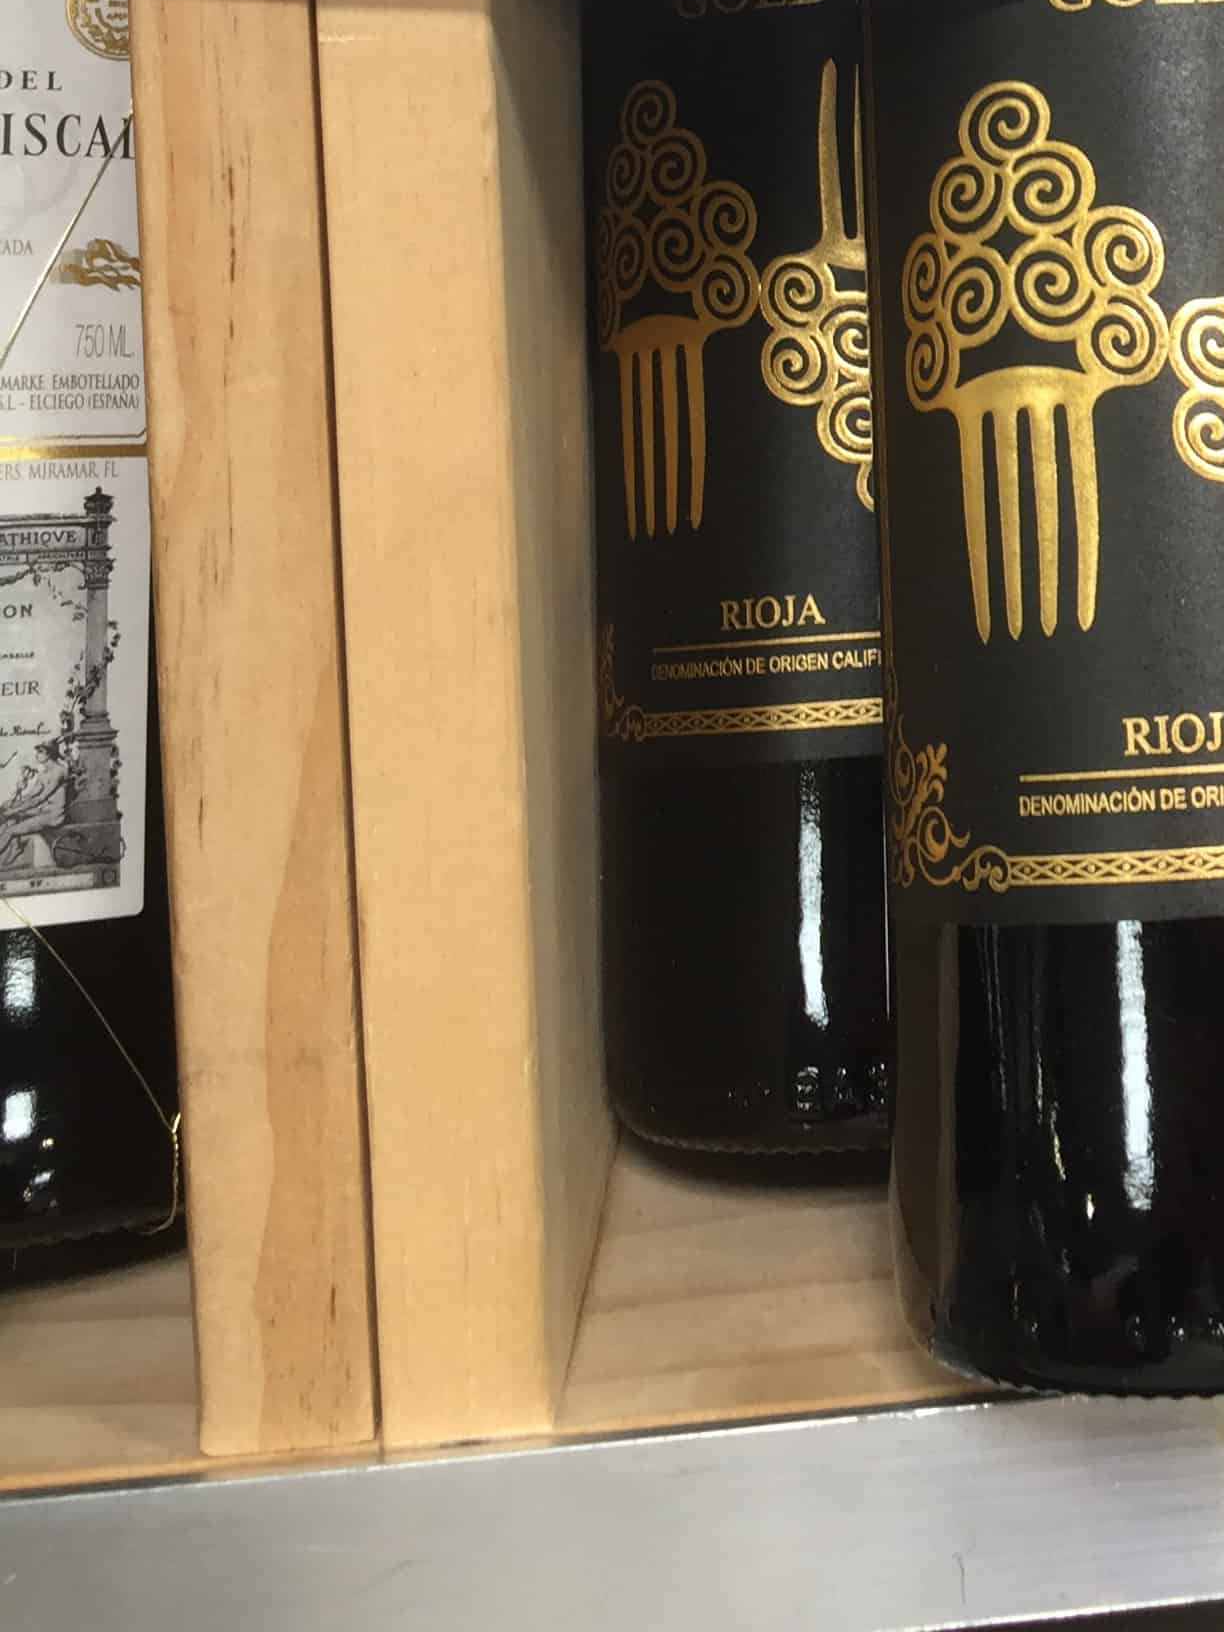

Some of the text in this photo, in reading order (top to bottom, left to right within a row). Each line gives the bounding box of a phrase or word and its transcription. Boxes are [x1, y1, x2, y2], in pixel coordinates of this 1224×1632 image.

[0, 239, 33, 256] ADA
[76, 324, 105, 358] 750
[52, 373, 140, 392] EMBOTELLADO
[30, 393, 85, 410] ELCIEGO
[720, 592, 826, 631] RIOJA
[746, 657, 767, 675] DE
[769, 652, 829, 674] ORIGEN
[1018, 785, 1156, 817] DENOMINACIÓN
[1160, 787, 1188, 811] DE
